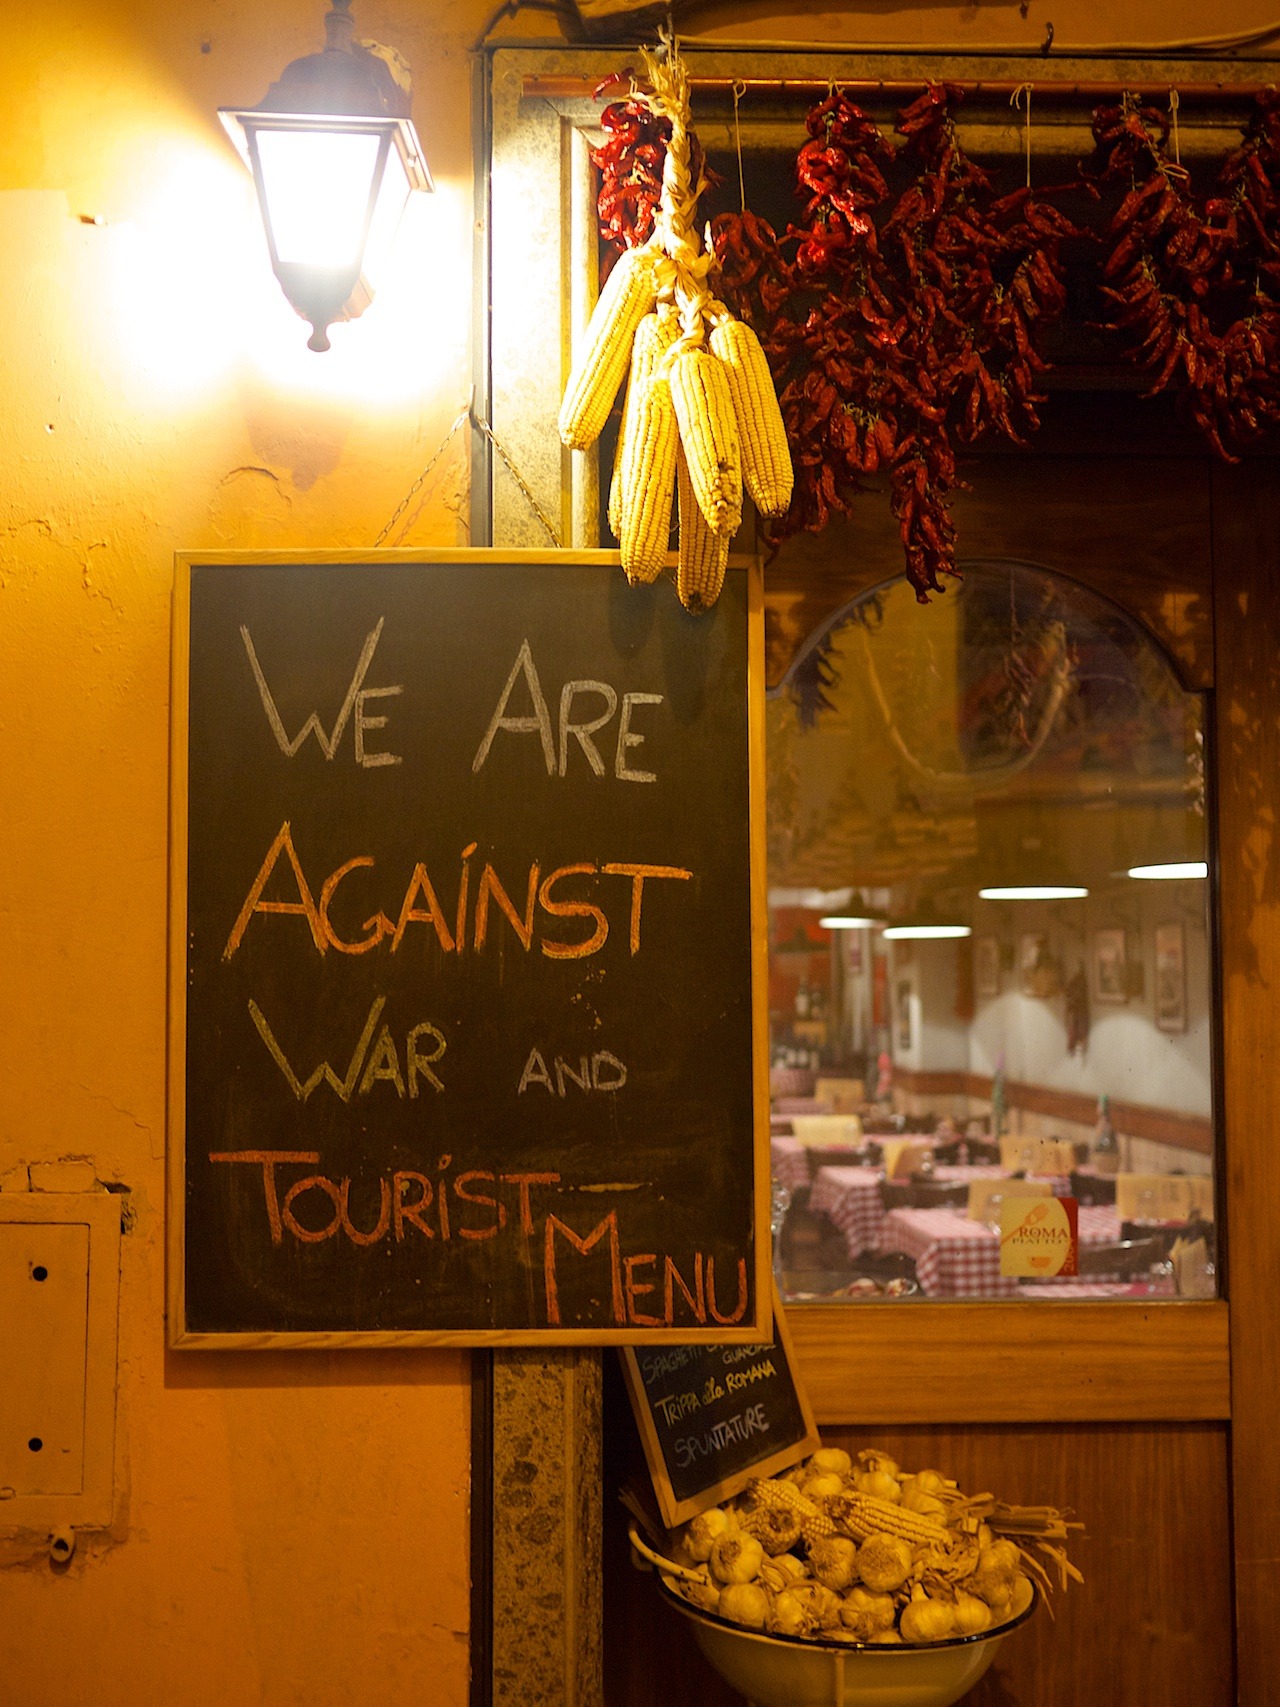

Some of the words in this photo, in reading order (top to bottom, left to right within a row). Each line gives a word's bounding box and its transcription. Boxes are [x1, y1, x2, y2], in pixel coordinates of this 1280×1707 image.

[239, 616, 404, 768] WE
[472, 638, 664, 782] ARE
[248, 995, 447, 1102] WAR
[517, 1047, 628, 1098] AND
[544, 1210, 748, 1328] MENU
[1019, 1227, 1068, 1238] ROMA
[725, 1359, 778, 1395] ROMANA
[674, 1402, 770, 1468] SPUNTATURE
